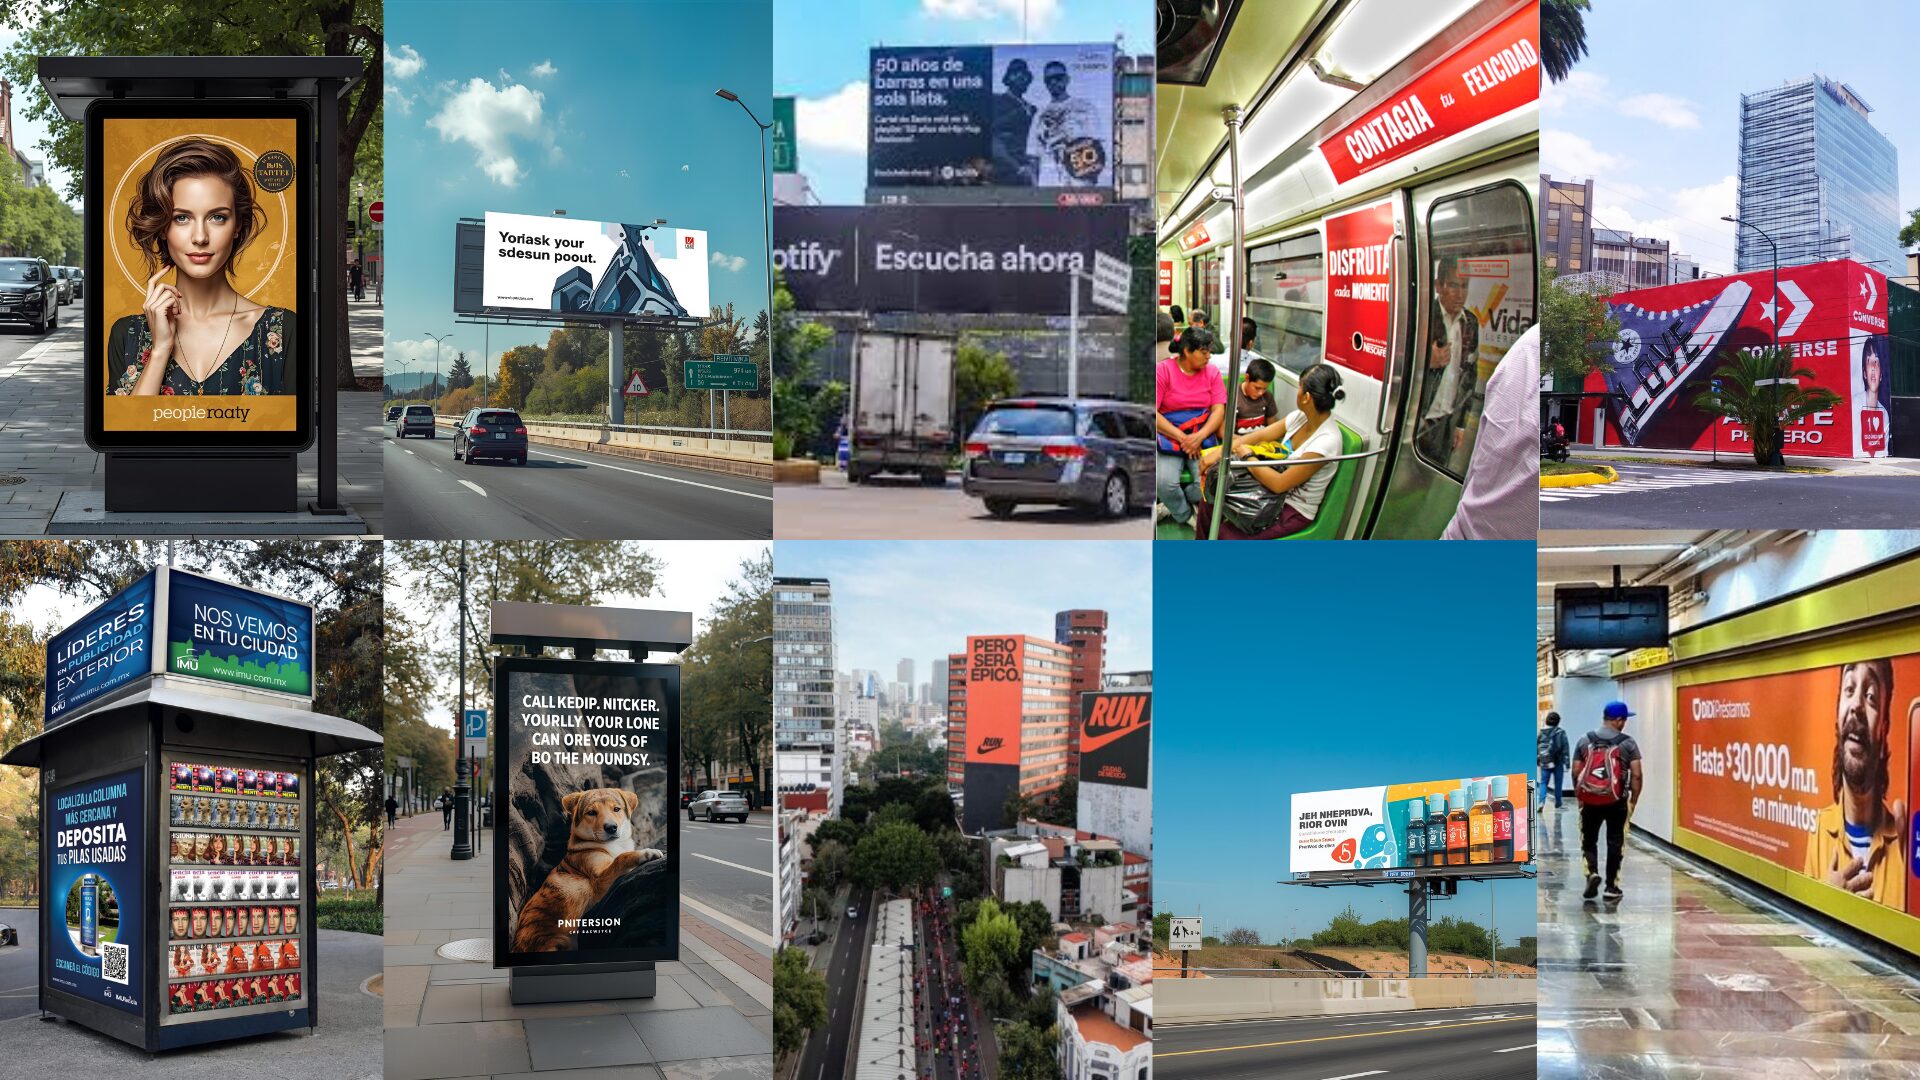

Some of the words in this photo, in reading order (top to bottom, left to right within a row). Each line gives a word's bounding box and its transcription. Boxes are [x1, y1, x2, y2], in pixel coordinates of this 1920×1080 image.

[875, 58, 897, 72] 50
[942, 56, 964, 72] de
[875, 75, 924, 89] barras
[928, 78, 949, 89] en
[953, 77, 983, 89] una
[874, 90, 907, 106] sola
[1345, 94, 1435, 164] CONTAGIA
[1440, 92, 1455, 108] tu
[1461, 38, 1537, 96] FELICIDAD
[554, 238, 585, 249] your
[498, 246, 551, 261] sdesun
[554, 252, 597, 264] poout.
[876, 243, 995, 271] Escucha
[1002, 244, 1084, 272] ahora
[1334, 284, 1350, 298] cada
[1853, 310, 1886, 329] CONVERSE
[1617, 319, 1702, 421] LOVE
[194, 603, 233, 628] NOS
[236, 613, 298, 643] VEMOS
[57, 602, 145, 665] LÍDERES
[194, 623, 214, 641] EN
[217, 628, 238, 646] TU
[240, 634, 298, 660] CIUDAD
[58, 667, 67, 676] EN
[68, 623, 144, 670] PUBLICIDAD
[974, 638, 1017, 652] PERO
[57, 638, 144, 692] EXTERIOR
[70, 671, 131, 703] www.imu.com.mx
[213, 667, 288, 687] www.imu.com.mx
[522, 695, 556, 708] CALL
[603, 697, 660, 712] NITCKER.
[1088, 695, 1147, 728] RUN
[522, 714, 582, 728] YOURLLY
[586, 716, 622, 729] YOUR
[626, 717, 660, 730] LONE
[532, 732, 560, 746] CAN
[630, 735, 648, 748] OF
[982, 738, 1004, 748] RUN
[532, 752, 551, 764] BO
[554, 752, 579, 764] THE
[582, 752, 650, 766] MOUNDSY.
[1692, 743, 1725, 777] Hasta
[1725, 742, 1791, 790] $30,000
[1791, 766, 1819, 794] m.n.
[57, 793, 85, 811] LOCALIZA
[86, 792, 92, 804] LA
[93, 782, 127, 803] COLUMNA
[65, 809, 79, 826] MÁS
[79, 805, 111, 823] CERCANA
[112, 806, 117, 818] Y
[1299, 812, 1318, 820] JEH
[1752, 796, 1766, 818] en
[1299, 820, 1322, 830] RIOR
[1324, 818, 1348, 828] OVIN
[57, 822, 127, 848] DEPOSITA
[58, 854, 68, 864] TUS
[68, 847, 90, 865] PILAS
[91, 845, 127, 863] USADAS
[1339, 843, 1352, 863] 5
[558, 918, 621, 928] PNITERSION
[1172, 926, 1180, 938] 4
[56, 958, 76, 972] ESCANEA
[81, 963, 100, 978] CÓDIGO
